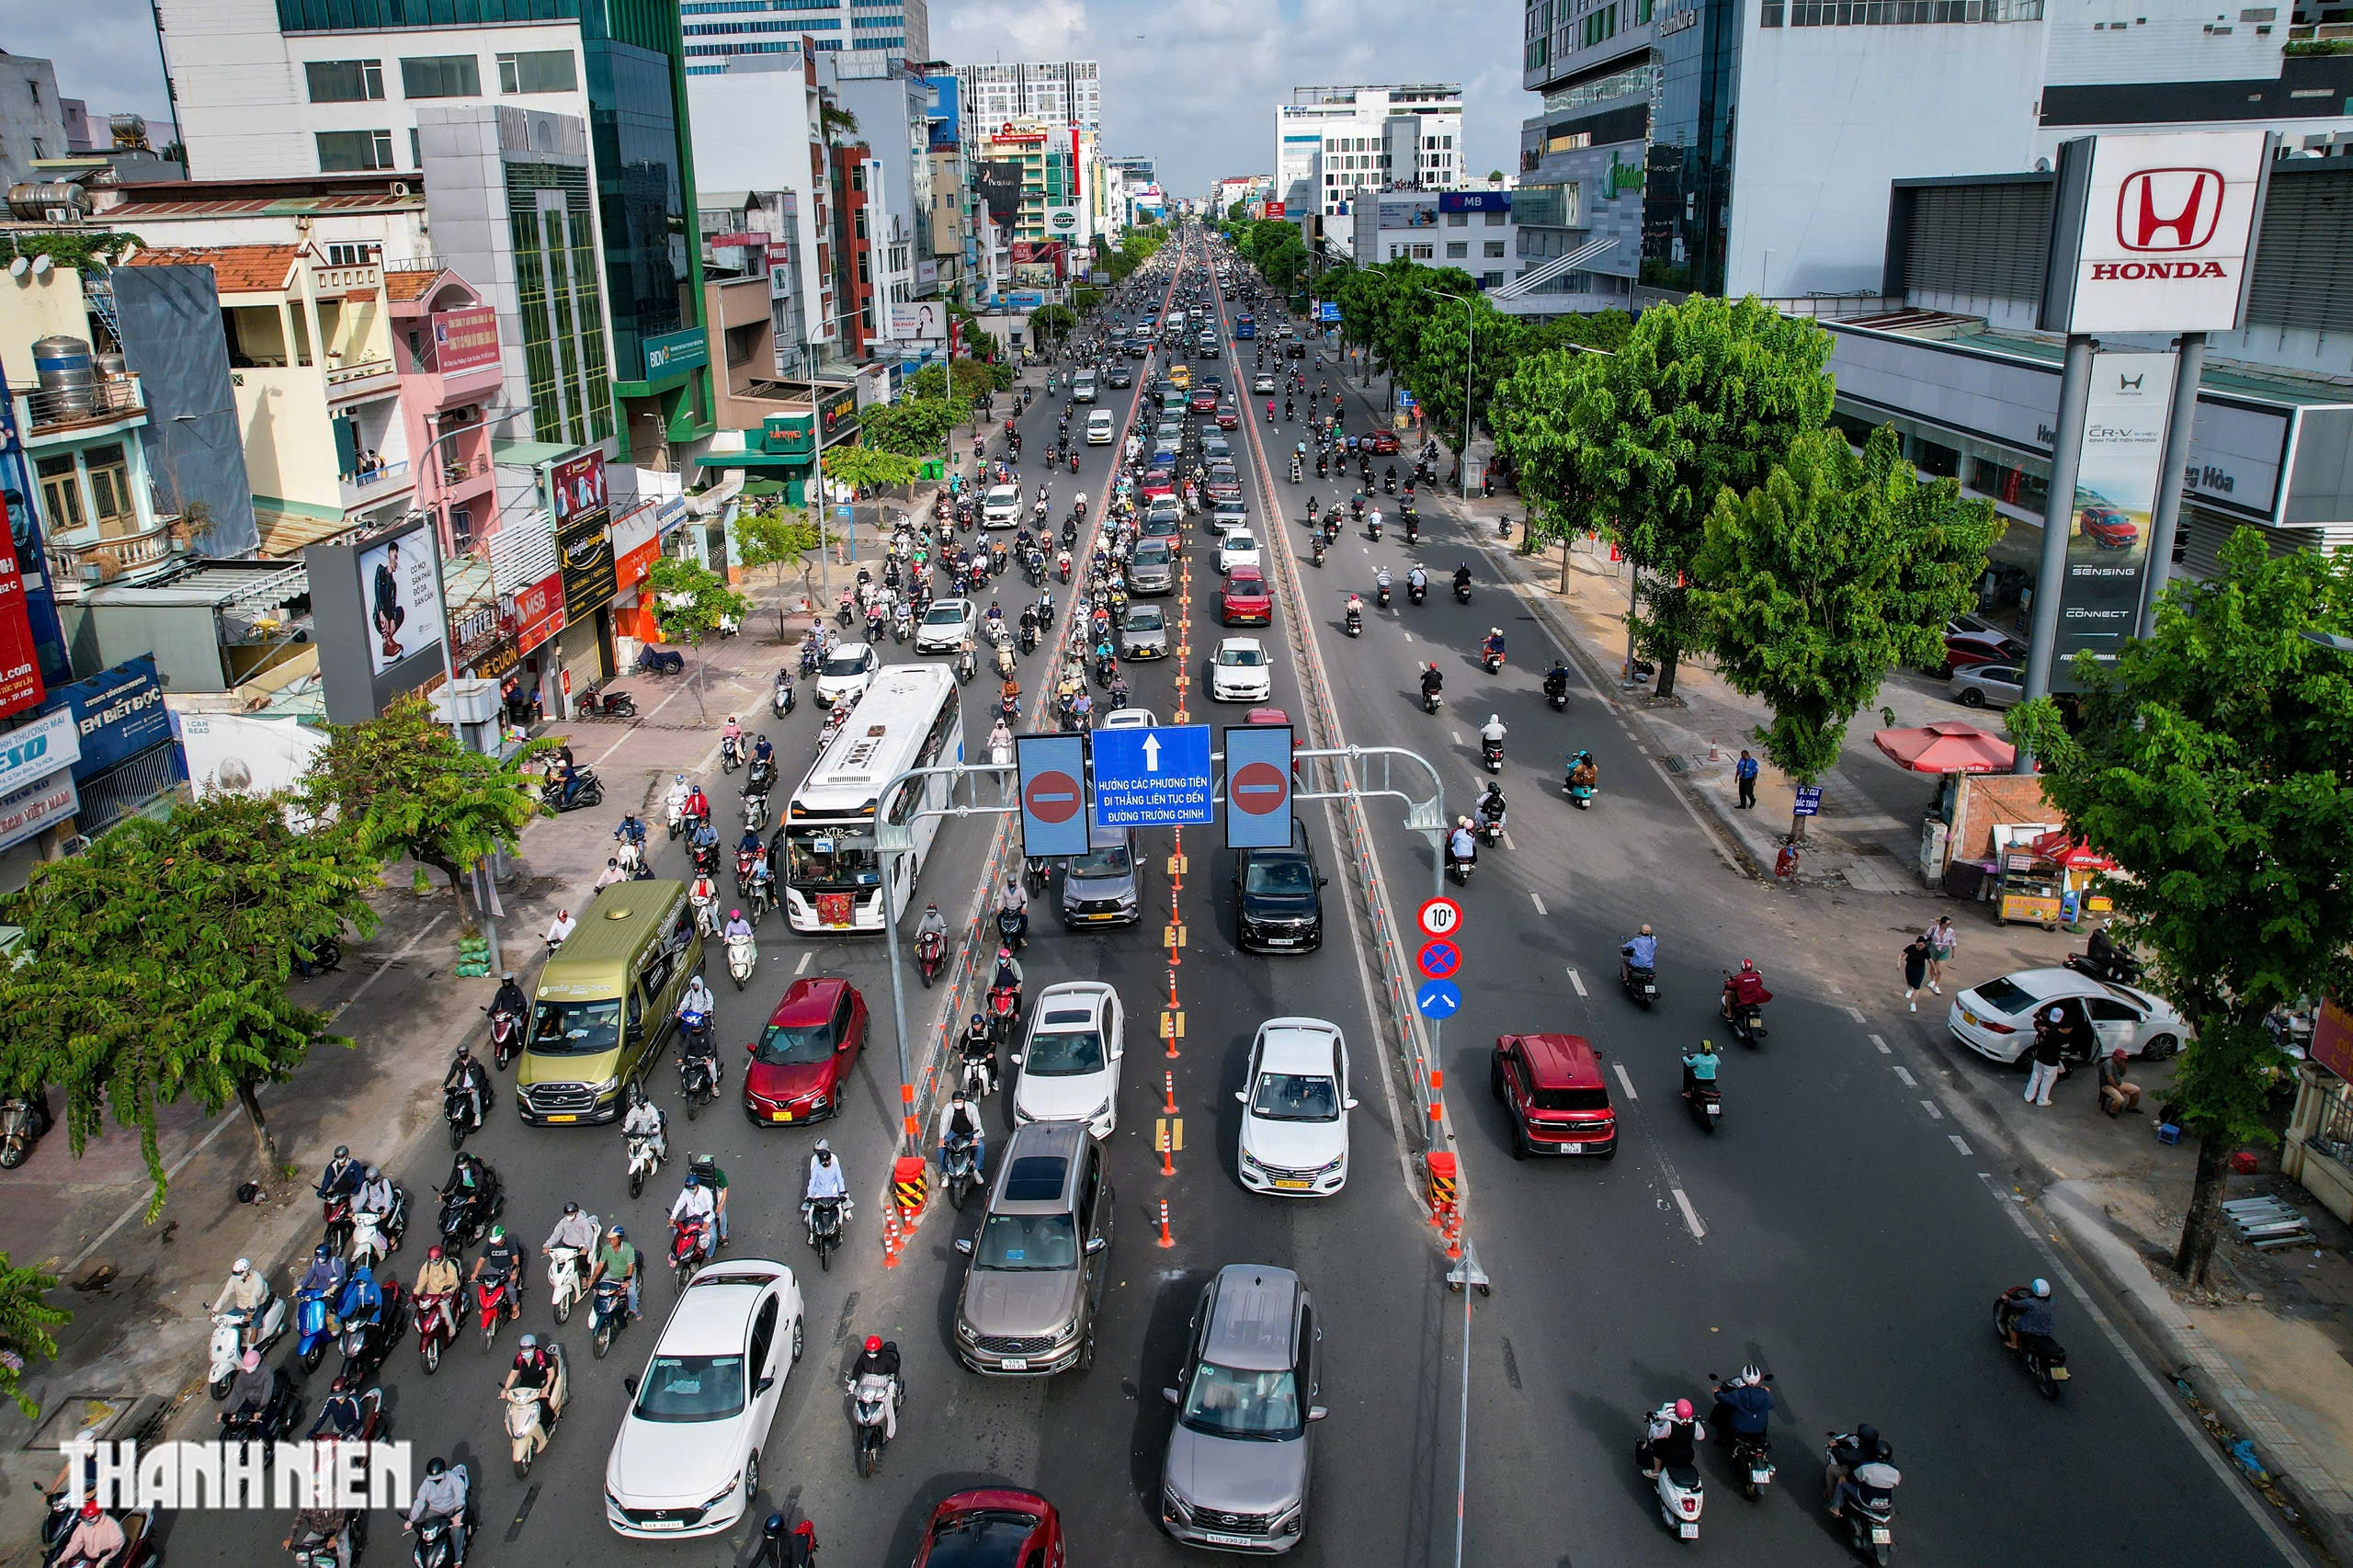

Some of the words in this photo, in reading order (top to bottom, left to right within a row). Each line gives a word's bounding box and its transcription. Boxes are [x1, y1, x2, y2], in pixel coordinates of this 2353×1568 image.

[1659, 8, 1696, 38] sumikura
[838, 52, 856, 63] FOR
[859, 51, 885, 62] RENT
[861, 64, 873, 76] 007
[874, 64, 886, 75] 503
[1464, 197, 1483, 207] MB
[2091, 261, 2227, 280] HONDA
[649, 349, 665, 368] BIDV
[2089, 428, 2132, 437] CR-V
[2204, 465, 2234, 494] Hòa
[525, 590, 546, 619] MSB
[79, 713, 103, 736] EM
[103, 698, 131, 725] BIẾT
[13, 722, 50, 744] THƯƠNG
[50, 715, 65, 731] MẠI
[1098, 777, 1130, 790] HƯỚNG
[1131, 777, 1149, 790] CÁC
[1150, 777, 1187, 789] PHƯƠNG
[1188, 776, 1208, 789] TIỆN
[23, 801, 46, 822] VIỆT
[47, 790, 71, 811] NAM
[1103, 795, 1113, 807] ĐI
[1114, 791, 1144, 807] THẲNG
[1145, 792, 1166, 805] LIÊN
[1167, 794, 1184, 807] TỤC
[1186, 790, 1204, 803] ĐẾN
[1108, 809, 1139, 823] ĐƯỜNG
[1141, 807, 1176, 821] TRƯỜNG
[1177, 808, 1204, 819] CHINH
[824, 827, 845, 836] VIP
[1210, 1536, 1248, 1545] 51L-230.22
